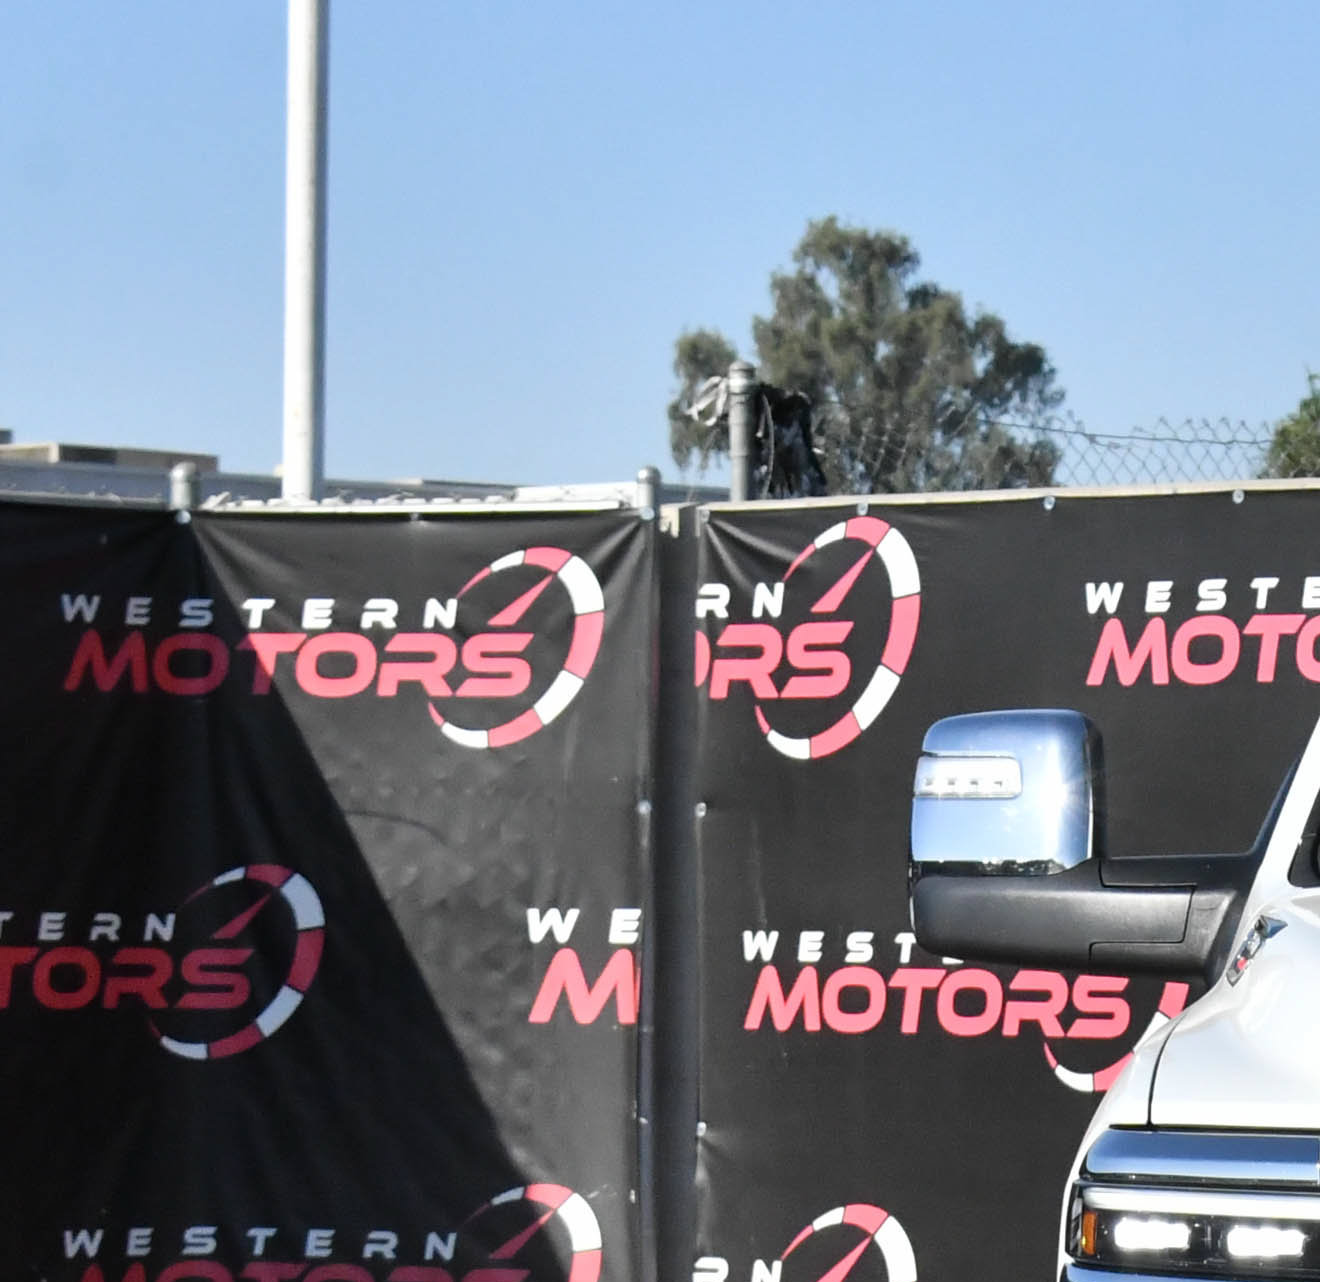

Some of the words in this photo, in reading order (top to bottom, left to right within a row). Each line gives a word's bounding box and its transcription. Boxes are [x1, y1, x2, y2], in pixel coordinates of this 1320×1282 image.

[62, 593, 458, 630] WESTERN
[64, 630, 535, 699] MOTORS
[694, 620, 855, 700] RS
[741, 929, 965, 965] WEST
[743, 964, 1131, 1040] MOTORS
[63, 1225, 457, 1260] WESTERN
